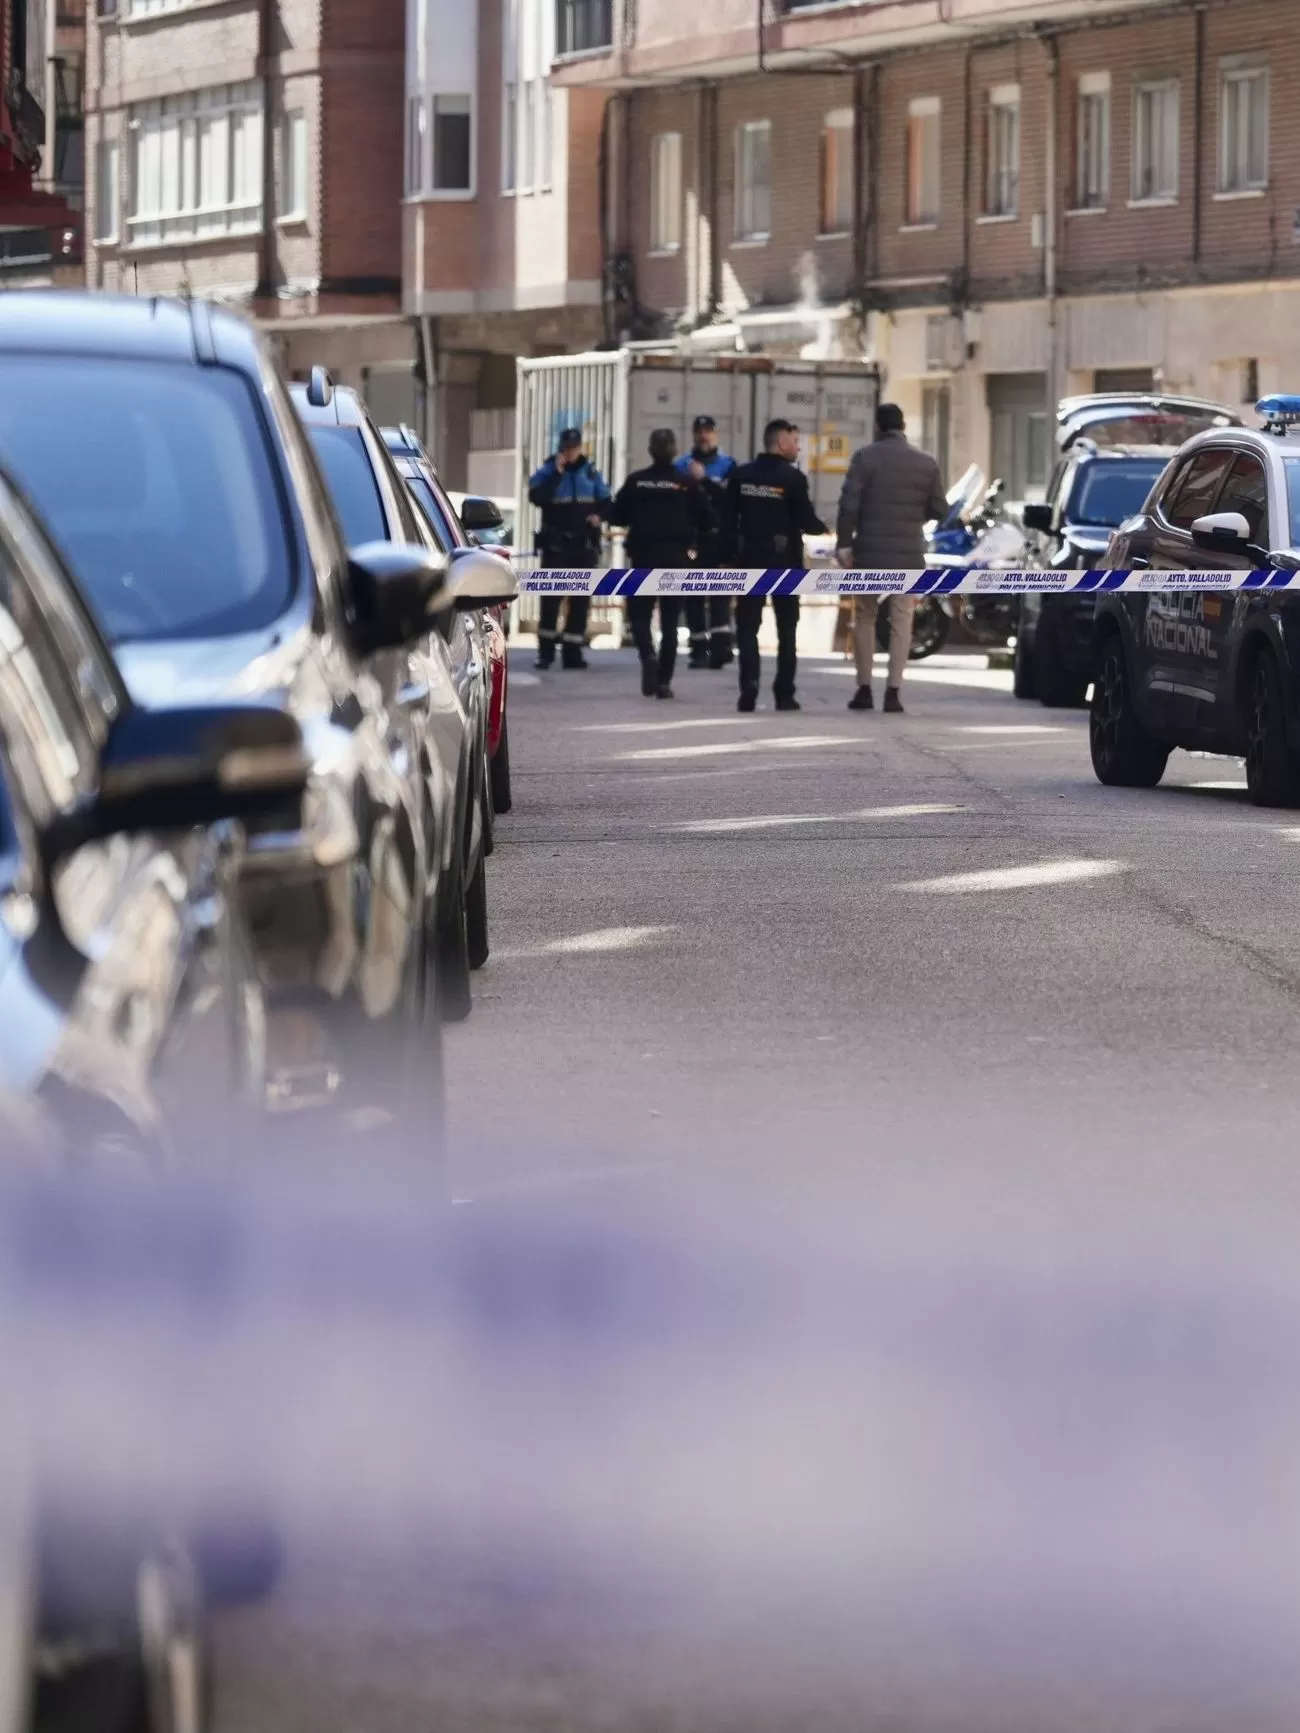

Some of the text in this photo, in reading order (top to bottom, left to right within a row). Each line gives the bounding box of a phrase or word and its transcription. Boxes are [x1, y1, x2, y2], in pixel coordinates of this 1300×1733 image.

[530, 572, 591, 580] AYTO. VALLADOLID
[685, 572, 747, 580] AYTO. VALLADOLID
[1004, 573, 1068, 582] AYTO. VALLADOLID
[1167, 574, 1232, 582] AYTO. VALLADOLID
[526, 582, 590, 591] POLICIA MUNICIPAL
[681, 583, 745, 591] POLICIA MUNICIPAL
[838, 583, 904, 591] POLICIA MUNICIPAL
[1146, 617, 1218, 660] NACIONAL
